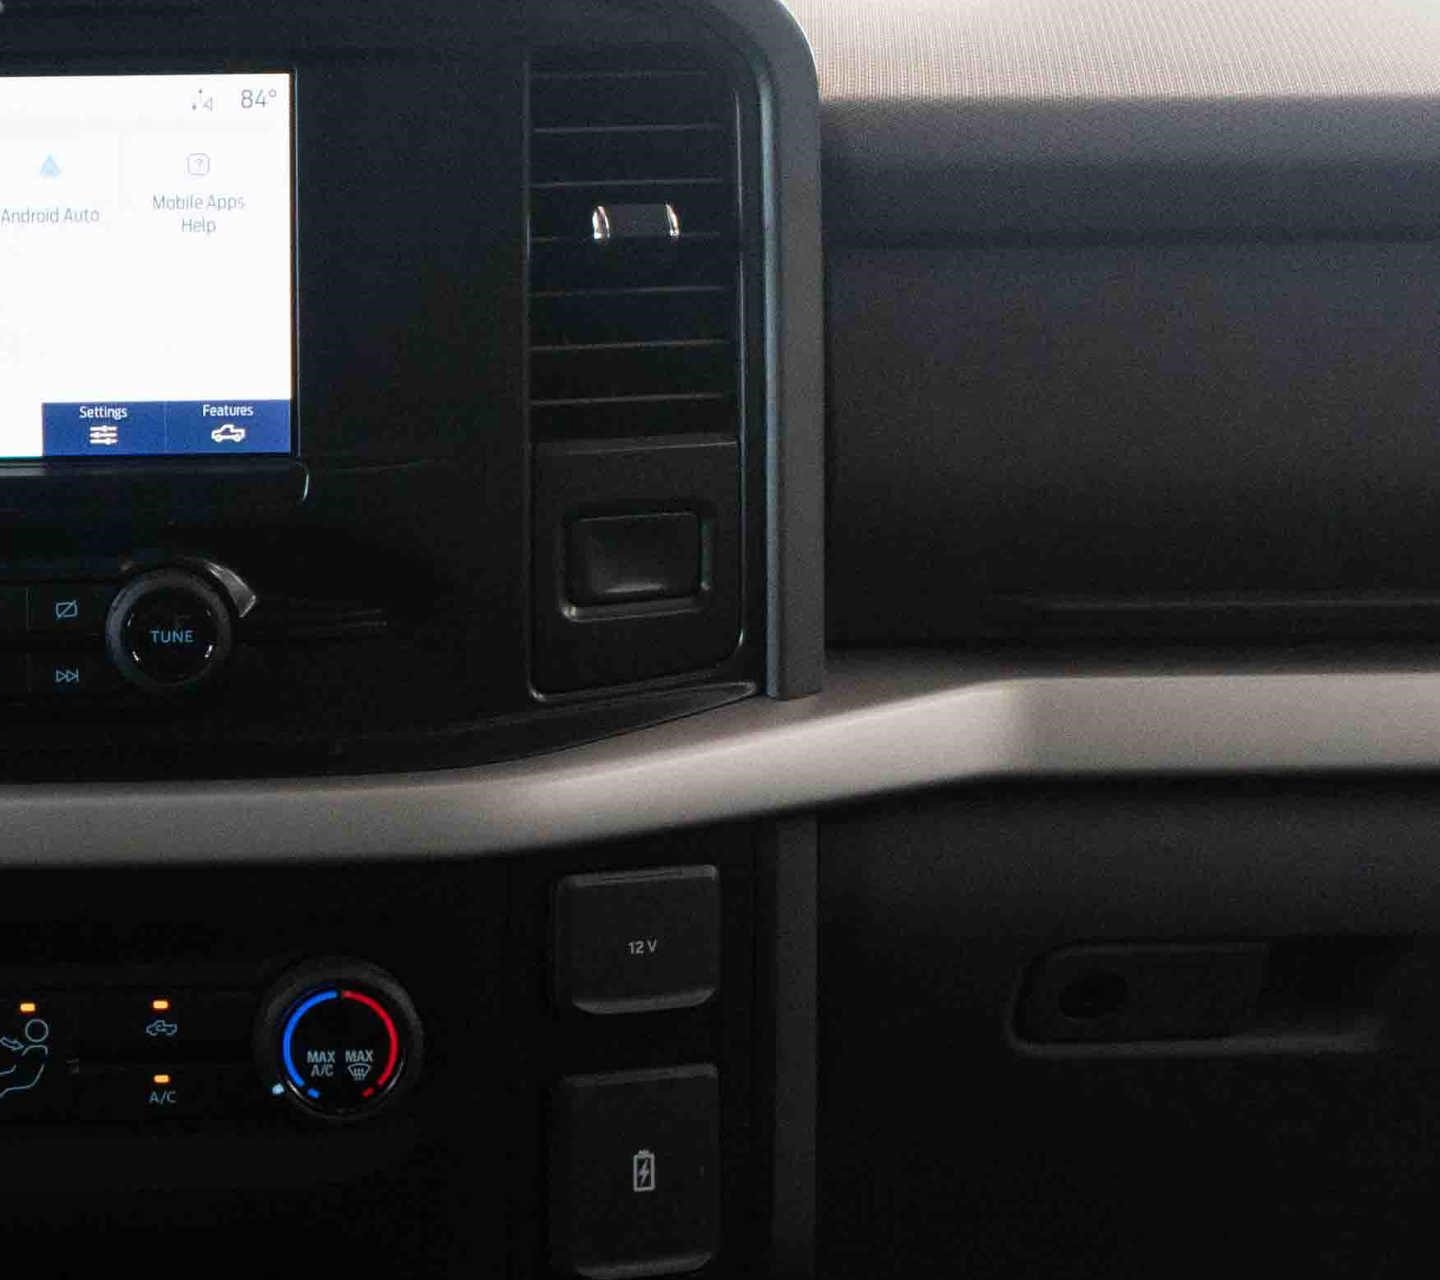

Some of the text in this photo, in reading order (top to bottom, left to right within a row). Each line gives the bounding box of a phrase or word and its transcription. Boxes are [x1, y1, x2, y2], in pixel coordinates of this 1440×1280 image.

[152, 194, 246, 212] Mobile Apps
[0, 207, 101, 225] Android Auto
[181, 218, 217, 236] Help
[78, 404, 128, 422] Settings
[201, 402, 254, 419] Features
[149, 629, 194, 644] TUNE
[627, 937, 658, 955] 12 V
[306, 1049, 336, 1063] MAX
[344, 1048, 374, 1063] MAX
[310, 1063, 334, 1077] A/C
[148, 1089, 177, 1106] A/C
